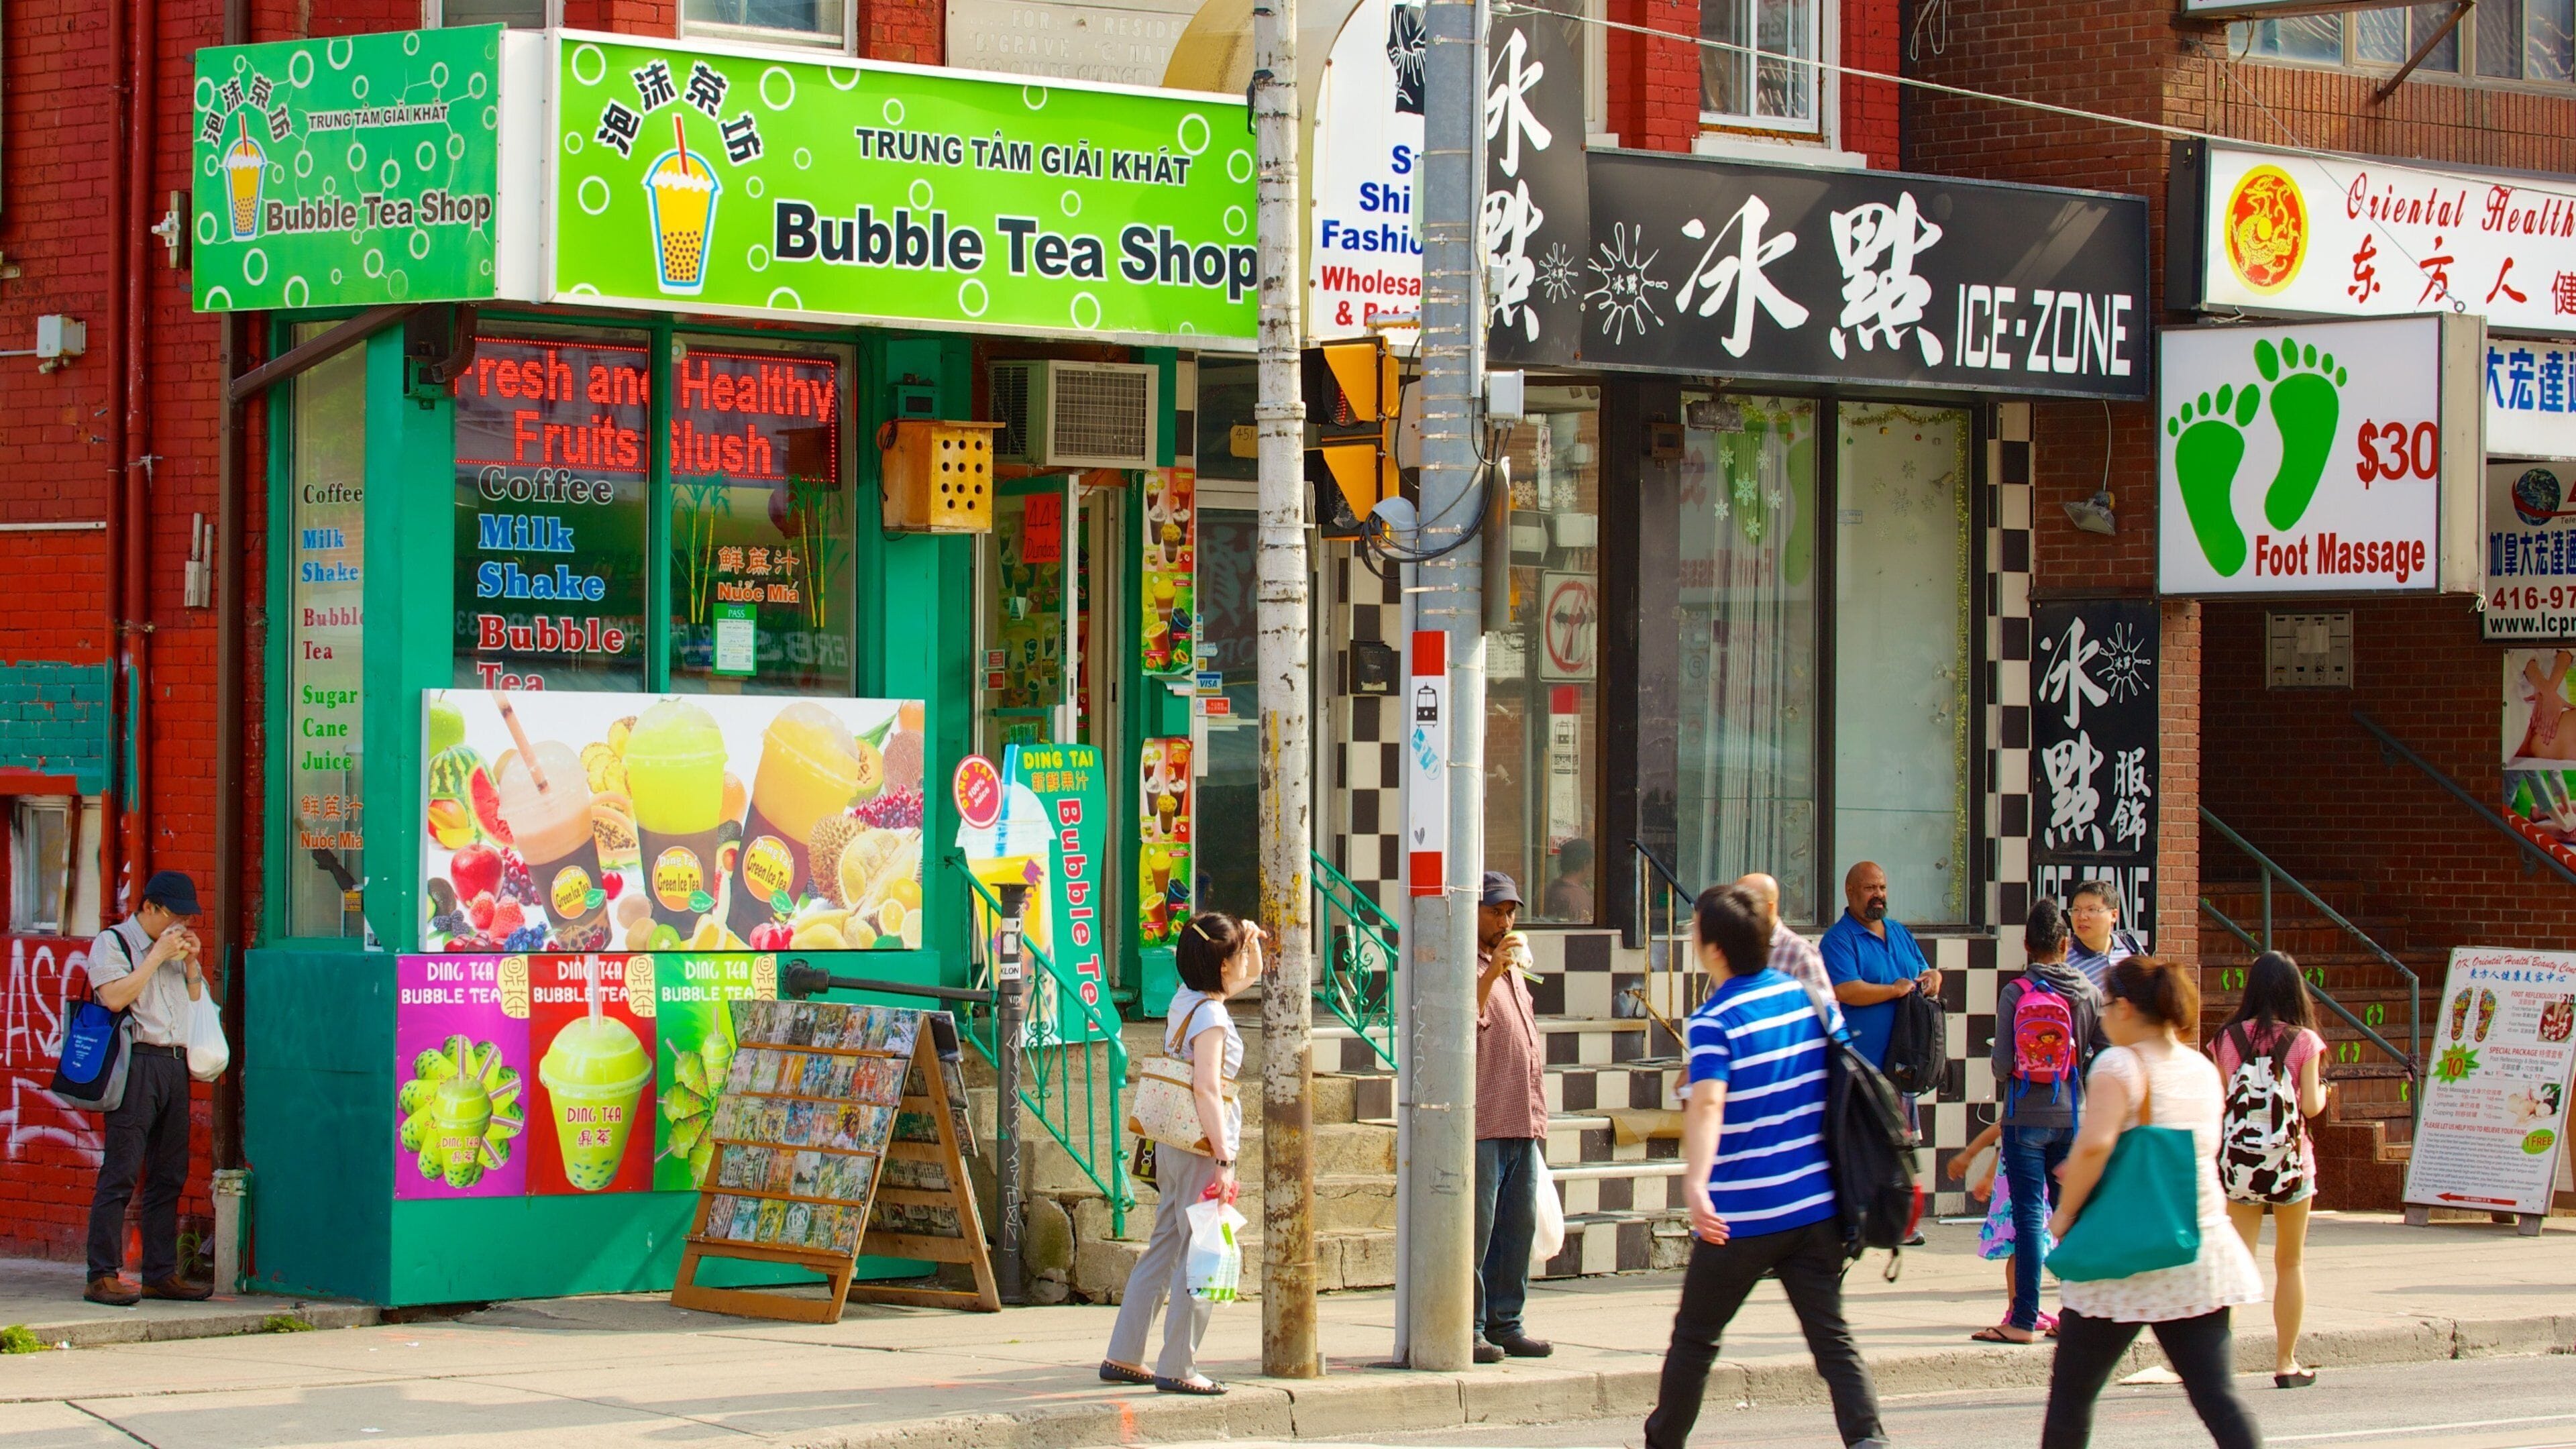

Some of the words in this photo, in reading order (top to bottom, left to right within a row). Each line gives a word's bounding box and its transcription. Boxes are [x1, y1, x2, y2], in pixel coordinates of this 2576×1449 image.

[1104, 17, 1189, 40] RESIDE
[203, 76, 290, 146] 泡沫茶坊
[309, 113, 352, 129] TRUNG
[596, 63, 762, 163] 泡沫茶坊
[857, 128, 962, 164] TRUNG
[972, 131, 1032, 172] TÂM
[1112, 147, 1192, 185] KHÁT
[268, 199, 356, 232] Bubble
[364, 196, 413, 227] Tea
[421, 193, 491, 229] Shop
[2347, 172, 2467, 227] Oriental
[2481, 186, 2576, 237] Health
[775, 203, 984, 270] Bubble
[998, 217, 1106, 279] Tea
[1122, 226, 1257, 302] Shop
[1676, 191, 1943, 368] 冰點
[1335, 301, 1354, 326] &
[453, 350, 573, 401] resh
[681, 357, 834, 422] Healthy
[2487, 346, 2576, 413] 大宏達
[515, 410, 639, 467] Fruits
[1236, 428, 1254, 441] 451
[2356, 419, 2438, 490] $30
[303, 483, 363, 504] Coffee
[478, 464, 614, 505] Coffee
[1027, 500, 1061, 531] 449
[303, 529, 345, 550] Milk
[478, 513, 574, 553] Milk
[718, 545, 800, 576] 鮮蔗汁
[2255, 533, 2308, 577] Foot
[2316, 532, 2426, 584] Massage
[302, 561, 359, 583] Shake
[477, 561, 606, 602] Shake
[728, 609, 745, 619] PASS
[477, 614, 625, 653] Bubble
[303, 640, 333, 661] Tea
[477, 661, 545, 691] Tea
[1199, 680, 1218, 688] VISA
[302, 684, 358, 709] Sugar
[302, 718, 348, 738] Cane
[2038, 616, 2110, 853] 冰點
[301, 749, 353, 771] Juice
[1022, 750, 1063, 770] DING
[1069, 749, 1093, 768] TAI
[973, 762, 994, 781] TAI
[968, 776, 985, 799] 100%
[974, 786, 990, 808] Juice
[2110, 746, 2151, 853] 服飾
[658, 854, 682, 869] Ding
[747, 853, 767, 880] Green
[765, 864, 776, 885] Ice
[775, 870, 788, 891] Tea
[1057, 798, 1093, 947] Bubble
[657, 872, 677, 892] Green
[678, 873, 688, 892] Ice
[688, 873, 699, 892] Tea
[555, 892, 574, 908] Green
[570, 885, 581, 900] Ice
[578, 880, 590, 895] Tea
[427, 962, 464, 981] DING
[470, 961, 494, 981] TEA
[598, 961, 623, 980] TEA
[685, 960, 719, 980] DING
[724, 961, 748, 979] TEA
[2455, 958, 2470, 970] OK
[2472, 955, 2503, 967] Oriental
[2504, 955, 2531, 965] Health
[2532, 956, 2558, 971] Beauty
[401, 987, 465, 1004] BUBBLE
[469, 987, 502, 1004] TEA
[533, 986, 593, 1003] BUBBLE
[598, 986, 629, 1003] TEA
[661, 986, 720, 1002] BUBBLE
[724, 986, 755, 1001] TEA
[2524, 991, 2557, 1000] REFLEXOLOGY
[2489, 1046, 2512, 1055] SPECIAL
[2512, 1047, 2538, 1057] PACKAGE
[567, 1107, 597, 1124] DING
[600, 1106, 622, 1122] TEA
[442, 1137, 462, 1148] DING
[466, 1137, 480, 1147] TEA
[2532, 1136, 2553, 1146] FREE
